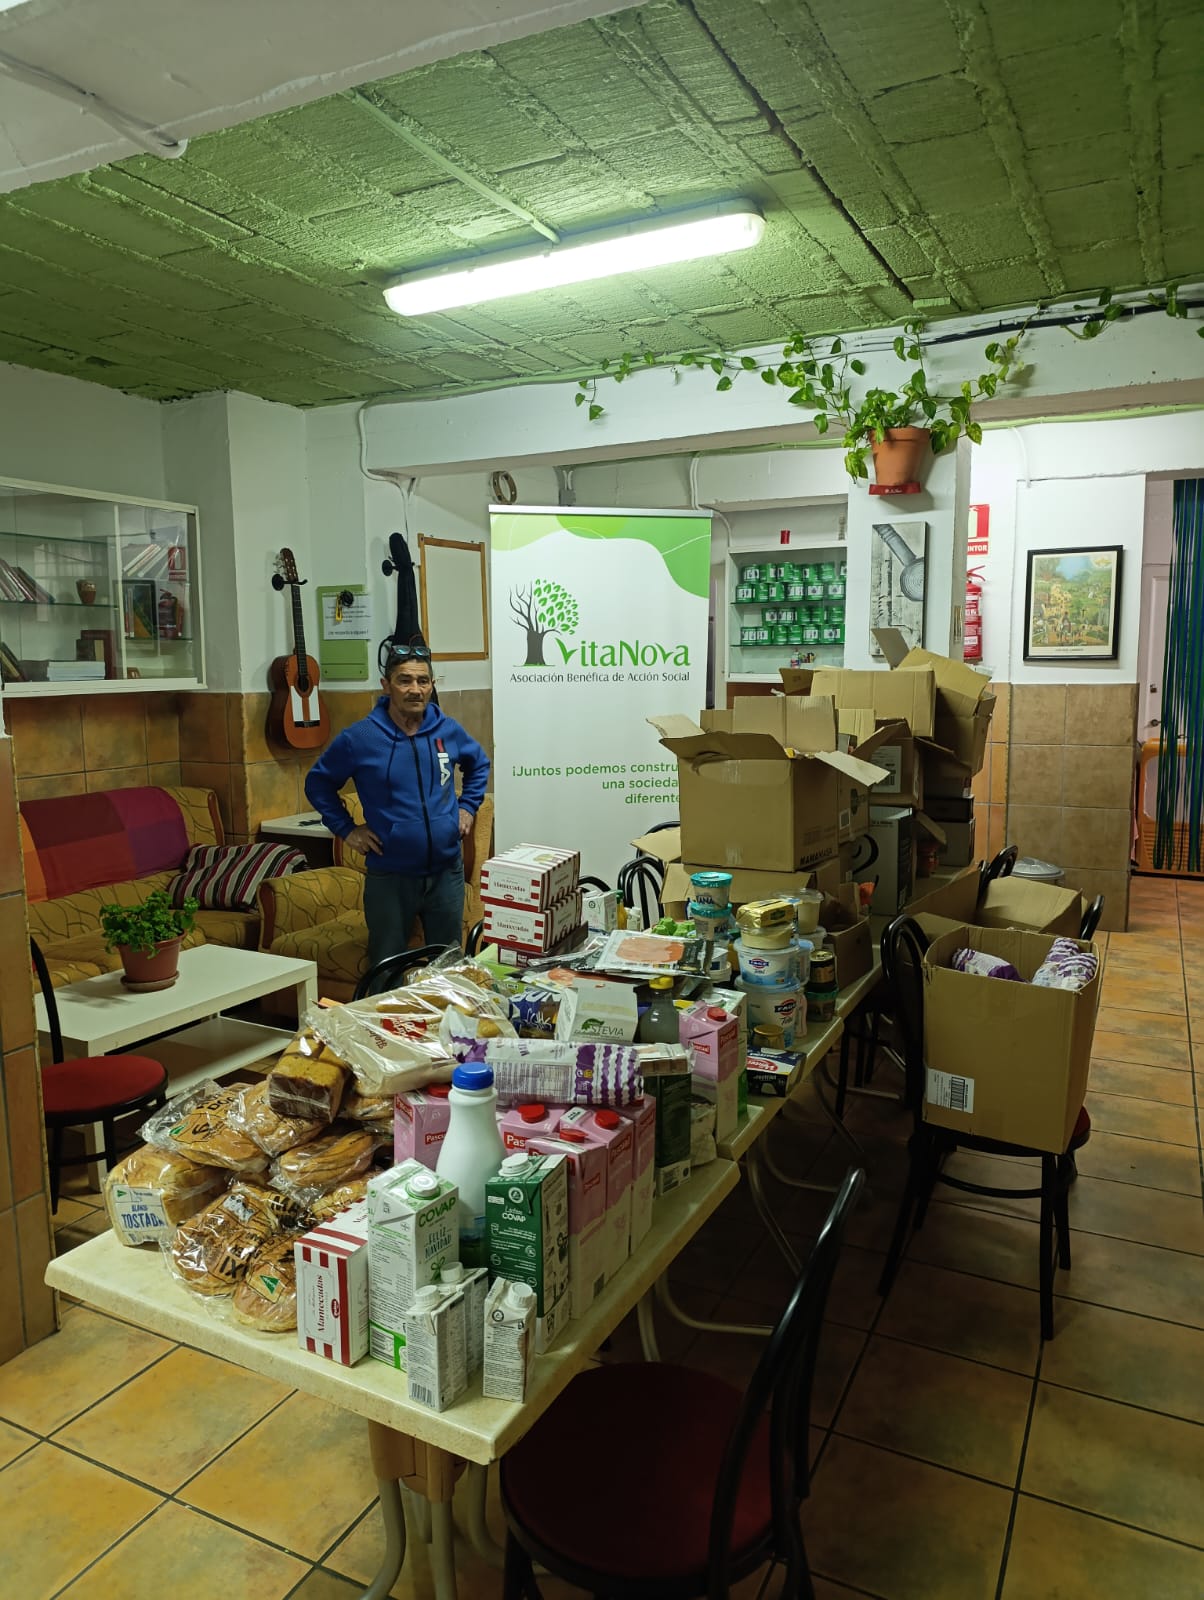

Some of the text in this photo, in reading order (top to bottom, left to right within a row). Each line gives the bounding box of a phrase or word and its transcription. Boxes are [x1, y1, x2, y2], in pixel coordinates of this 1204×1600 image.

[967, 544, 988, 552] INTOR
[555, 637, 691, 666] VitaNova
[510, 671, 690, 683] Asociación Benéfica de Acción Social
[565, 763, 627, 777] podemos
[630, 762, 679, 773] constru
[602, 777, 679, 789] una socieda
[591, 1024, 624, 1037] STEVIA
[426, 1134, 446, 1144] Pasc
[507, 1134, 525, 1148] Pas
[418, 1196, 456, 1228] COVAP
